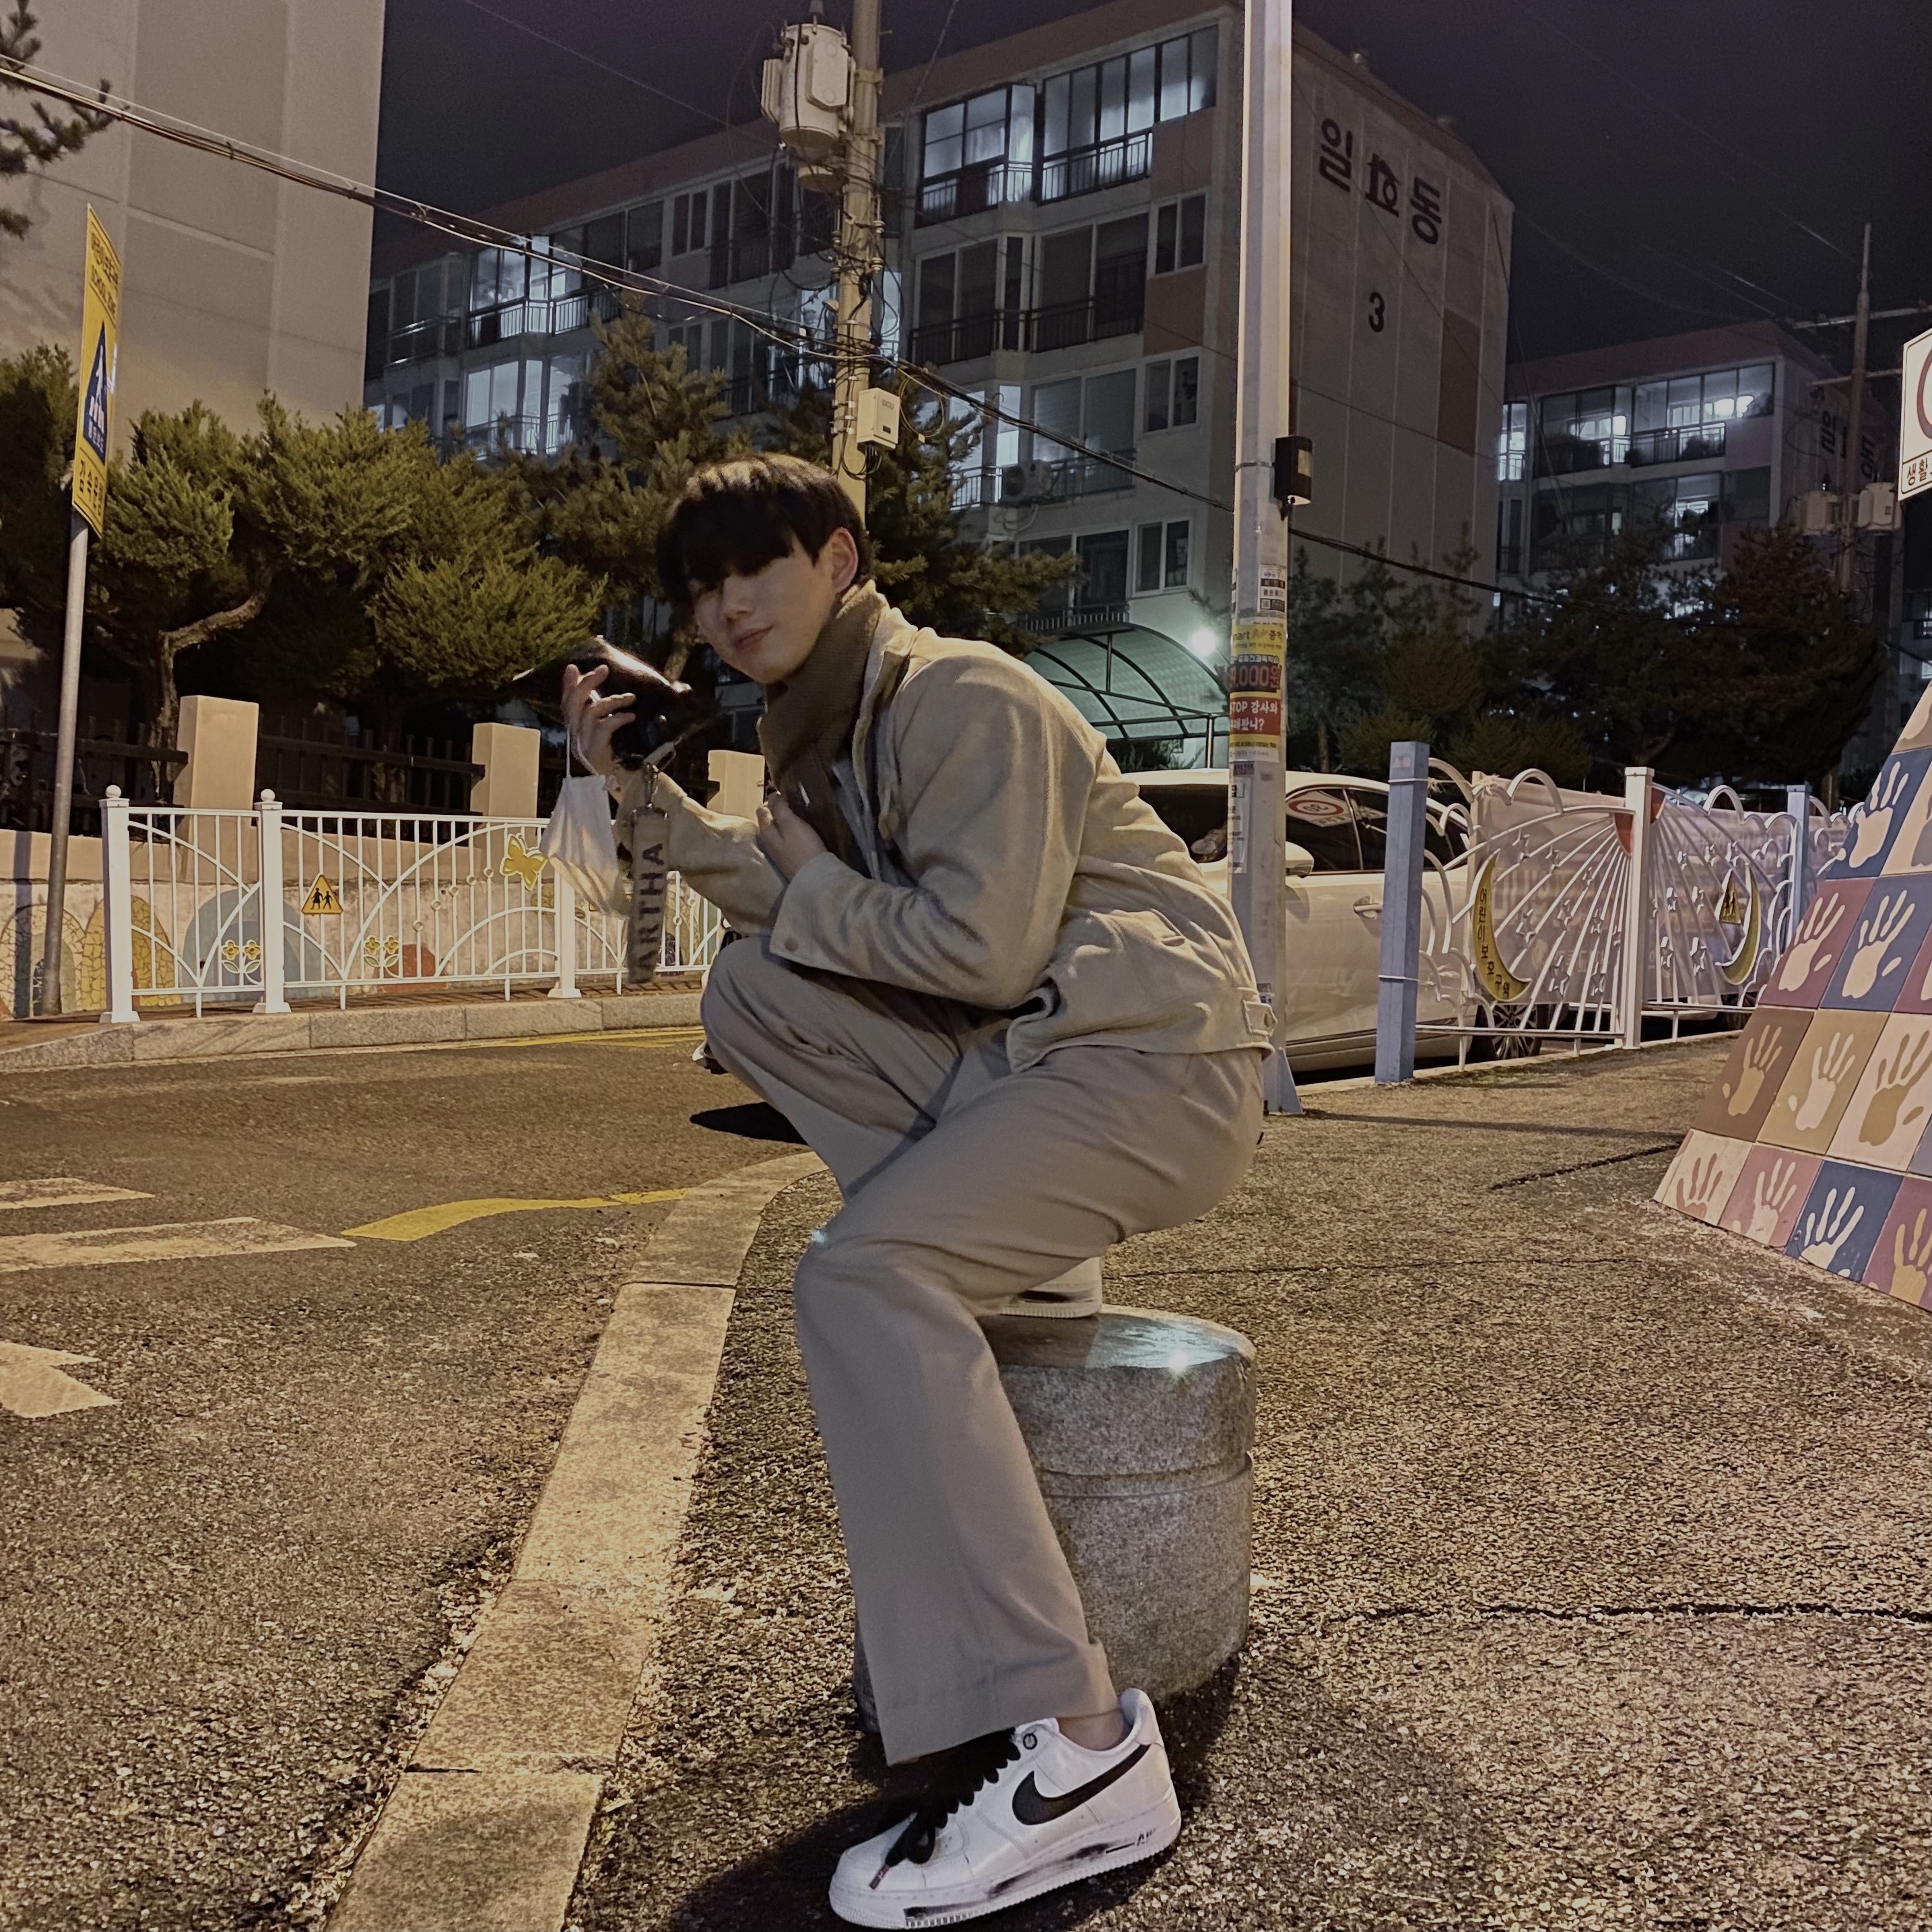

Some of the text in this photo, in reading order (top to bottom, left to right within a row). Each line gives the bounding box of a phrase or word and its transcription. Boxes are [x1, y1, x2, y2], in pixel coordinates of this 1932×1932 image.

[1368, 291, 1386, 333] 3
[1906, 457, 1932, 486] 생활
[1251, 700, 1278, 714] 강사와
